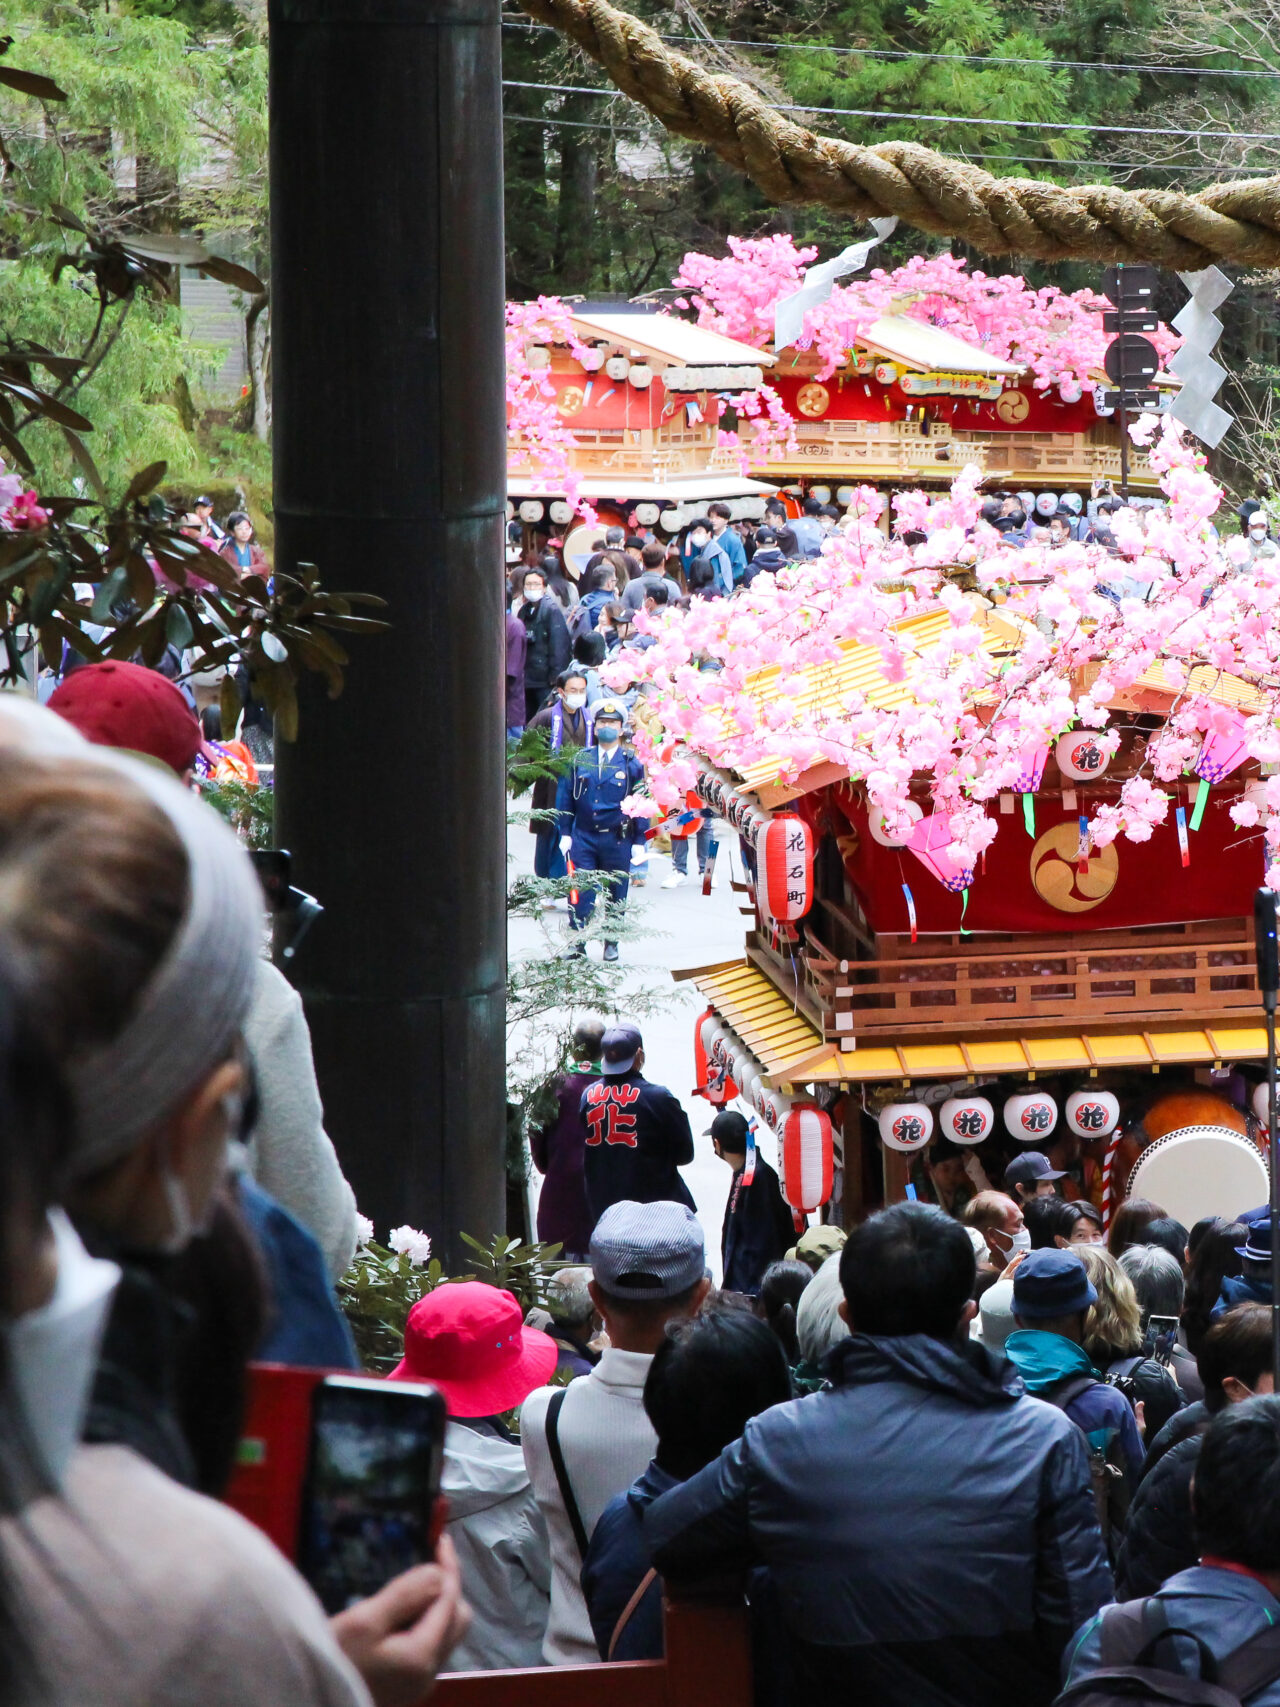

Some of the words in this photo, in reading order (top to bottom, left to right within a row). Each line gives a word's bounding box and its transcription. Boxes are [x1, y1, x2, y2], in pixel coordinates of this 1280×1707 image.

[1075, 744, 1102, 771] 花
[786, 832, 807, 906] 花石町
[956, 1111, 984, 1136] 花
[1024, 1105, 1051, 1129] 花
[1078, 1105, 1106, 1129] 花
[896, 1118, 923, 1142] 花
